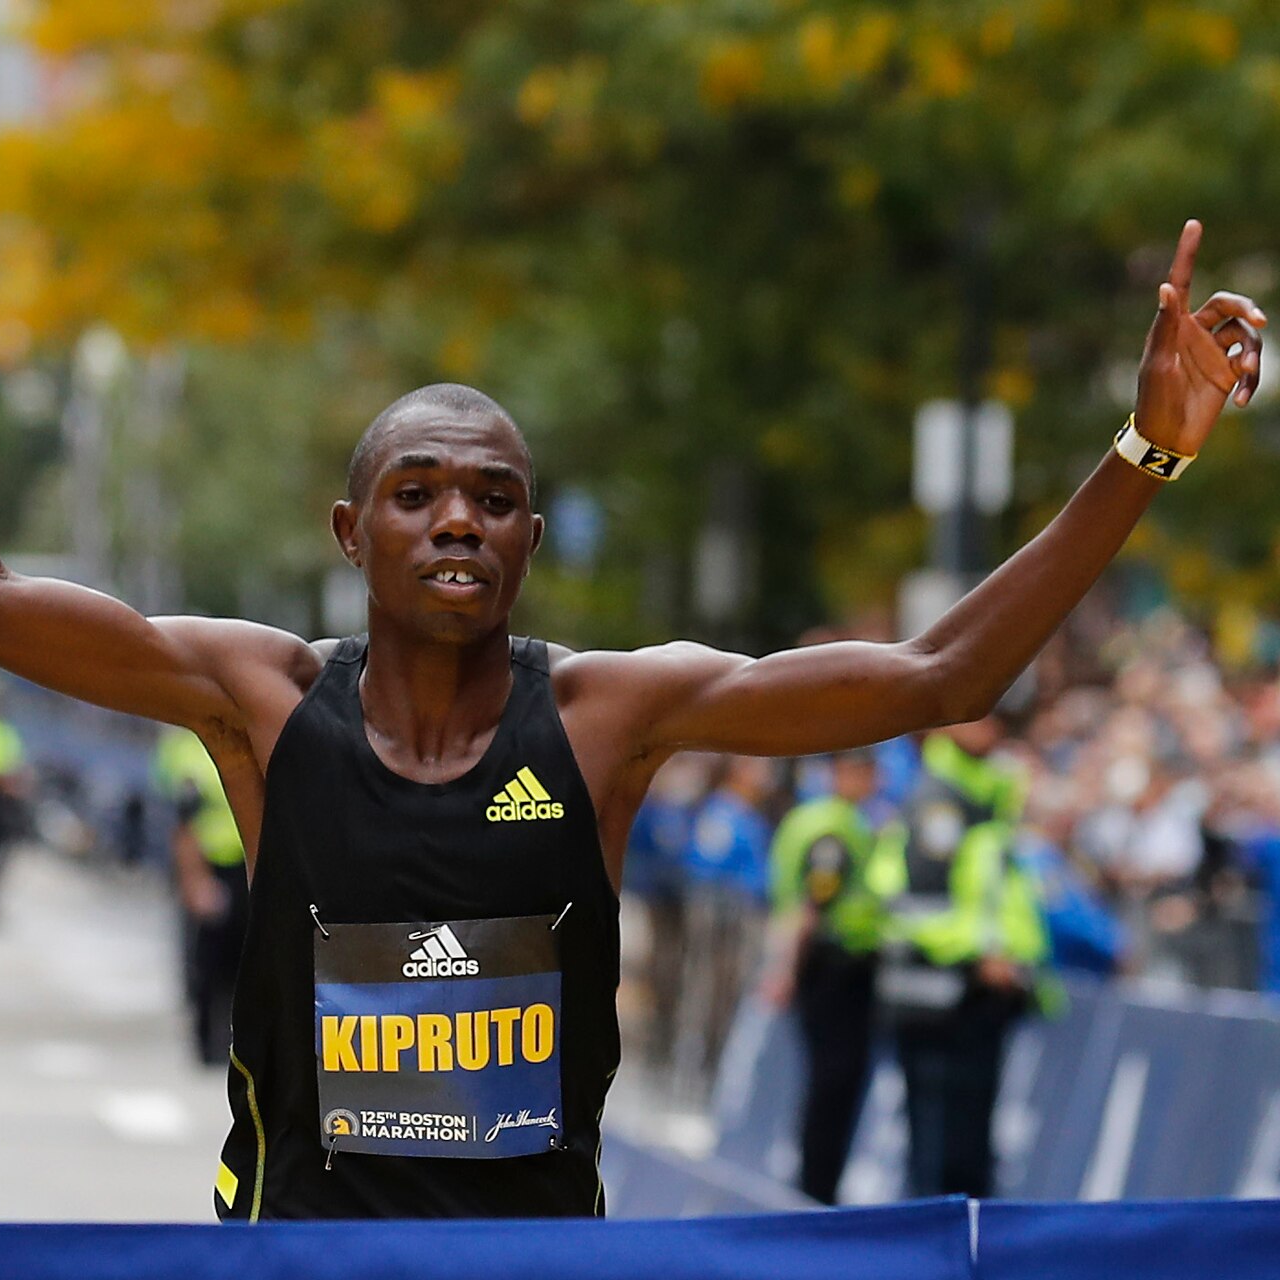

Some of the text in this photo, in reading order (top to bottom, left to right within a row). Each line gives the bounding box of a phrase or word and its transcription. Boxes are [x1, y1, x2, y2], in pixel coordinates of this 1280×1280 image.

[1146, 453, 1170, 475] 2
[486, 799, 565, 822] adidas
[402, 956, 480, 978] adidas
[322, 1003, 554, 1072] KIPRUTO
[360, 1111, 397, 1124] 125TH
[400, 1113, 466, 1128] BOSTON
